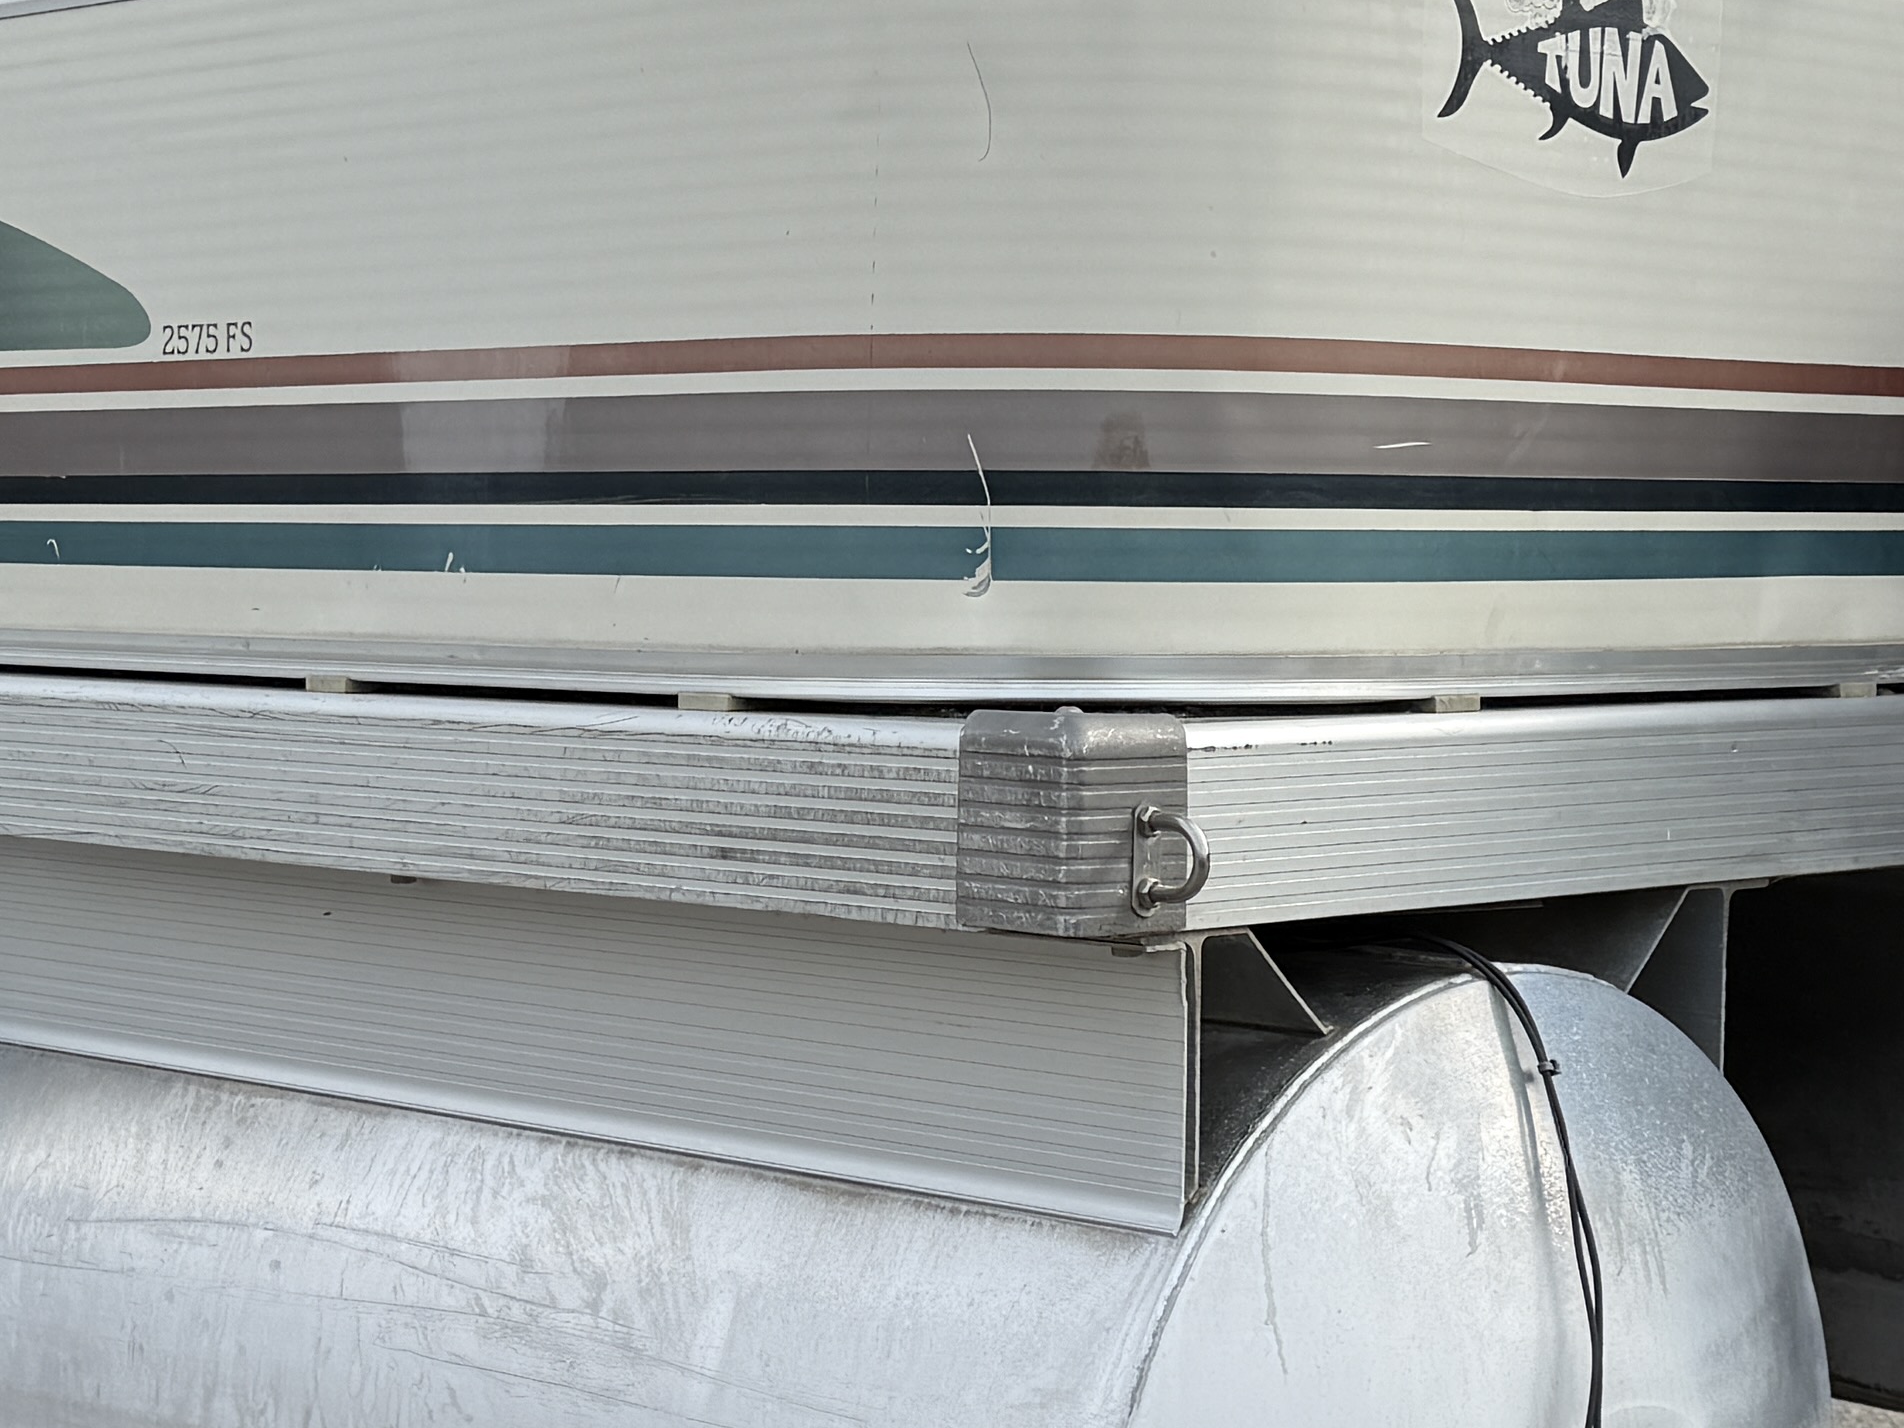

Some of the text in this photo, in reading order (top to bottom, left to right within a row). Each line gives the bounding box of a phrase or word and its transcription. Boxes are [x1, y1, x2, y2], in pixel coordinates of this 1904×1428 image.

[1537, 27, 1678, 124] TUNA
[162, 321, 253, 355] 2575 FS
